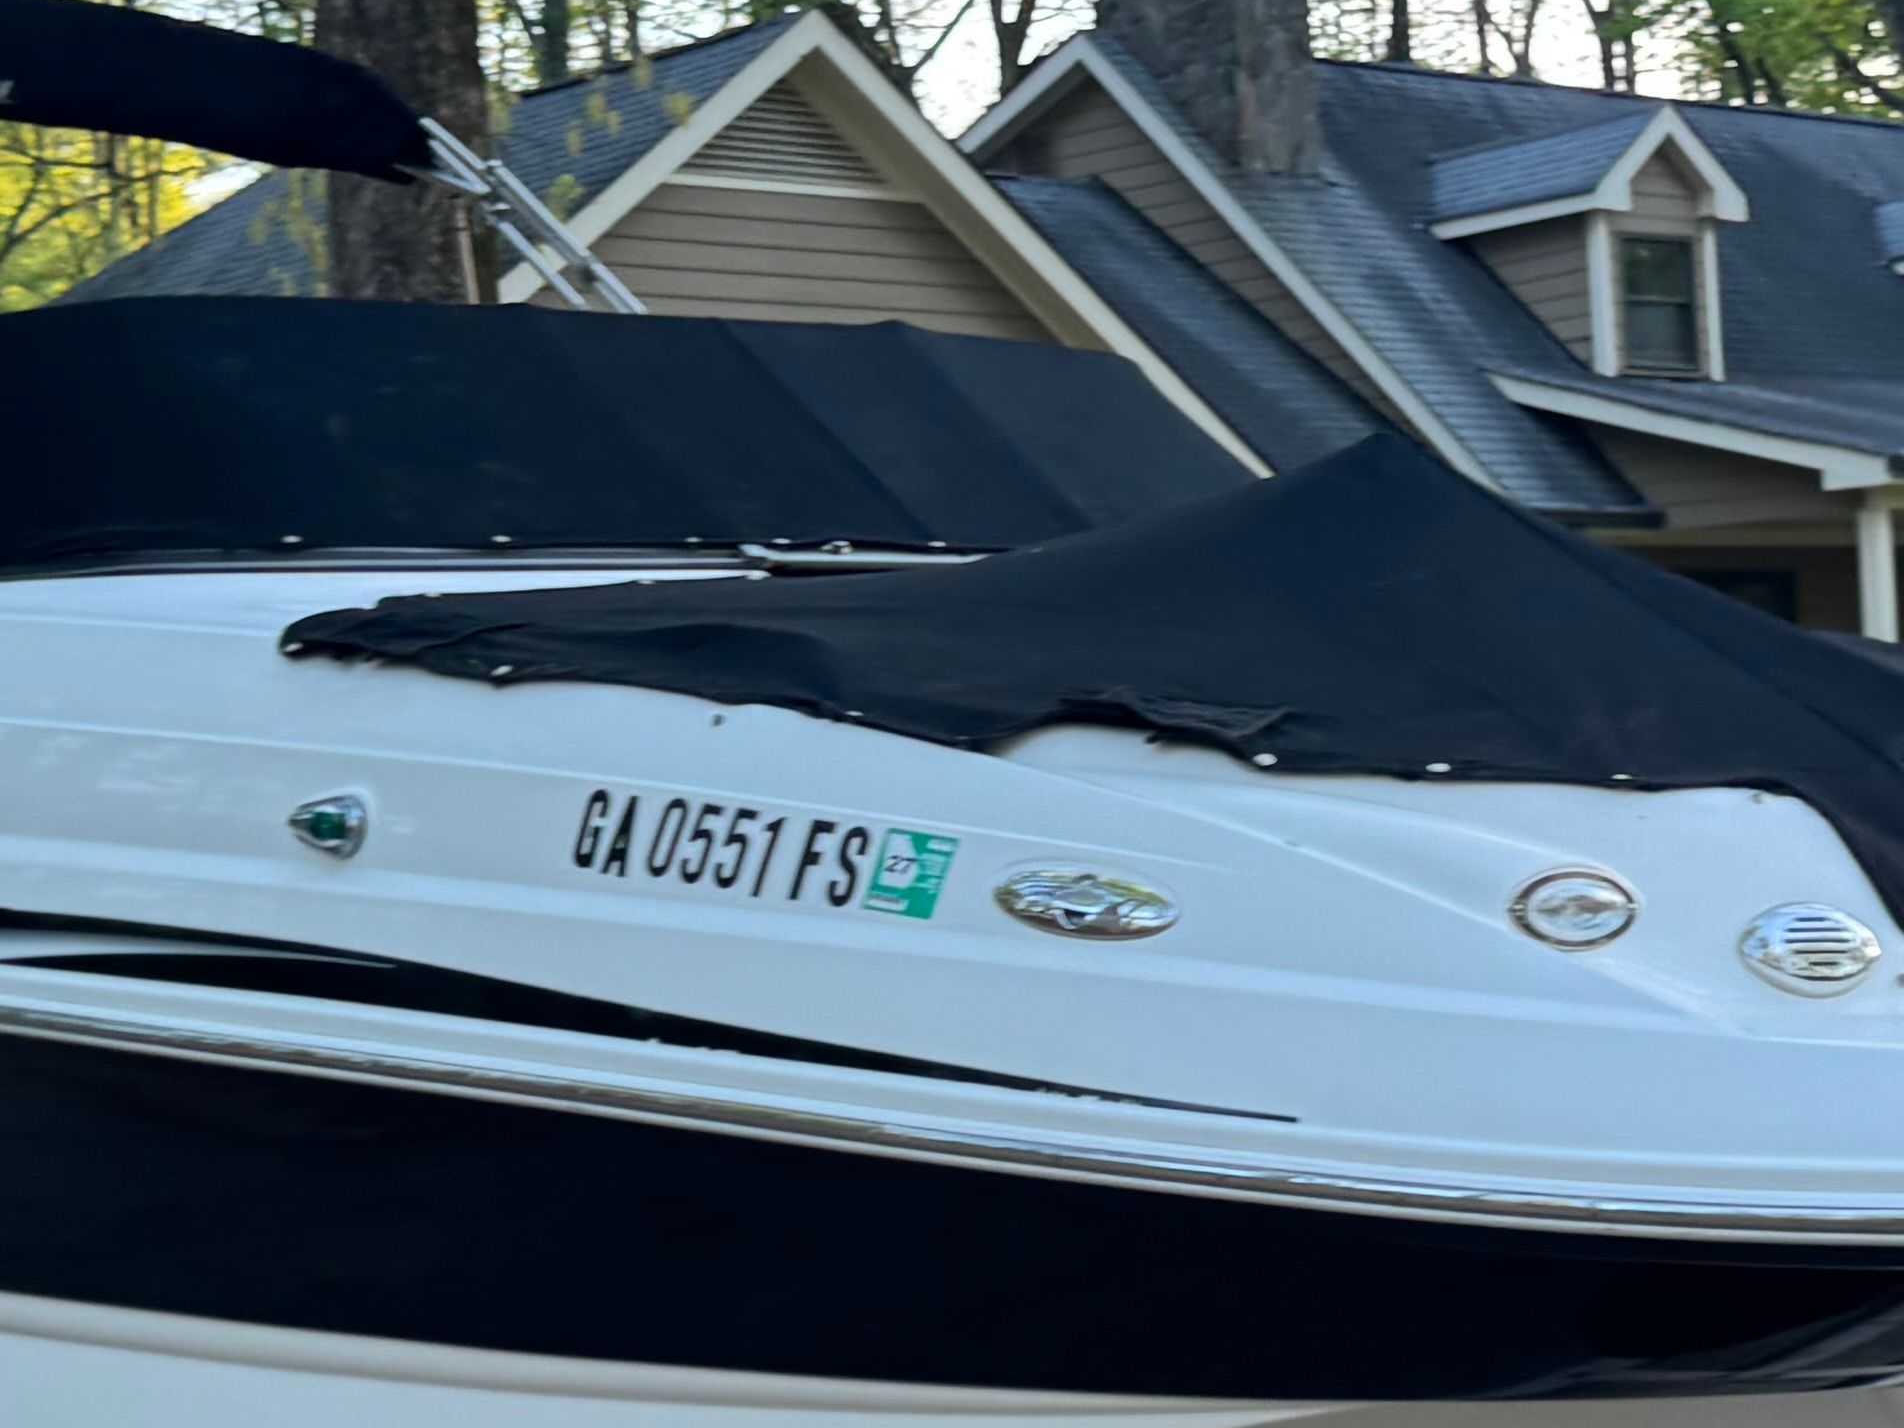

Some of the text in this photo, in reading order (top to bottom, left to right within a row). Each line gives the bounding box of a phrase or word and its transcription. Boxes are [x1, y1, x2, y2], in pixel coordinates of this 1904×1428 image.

[575, 788, 639, 877] GA
[648, 798, 788, 898] 0551
[788, 818, 869, 908] FS
